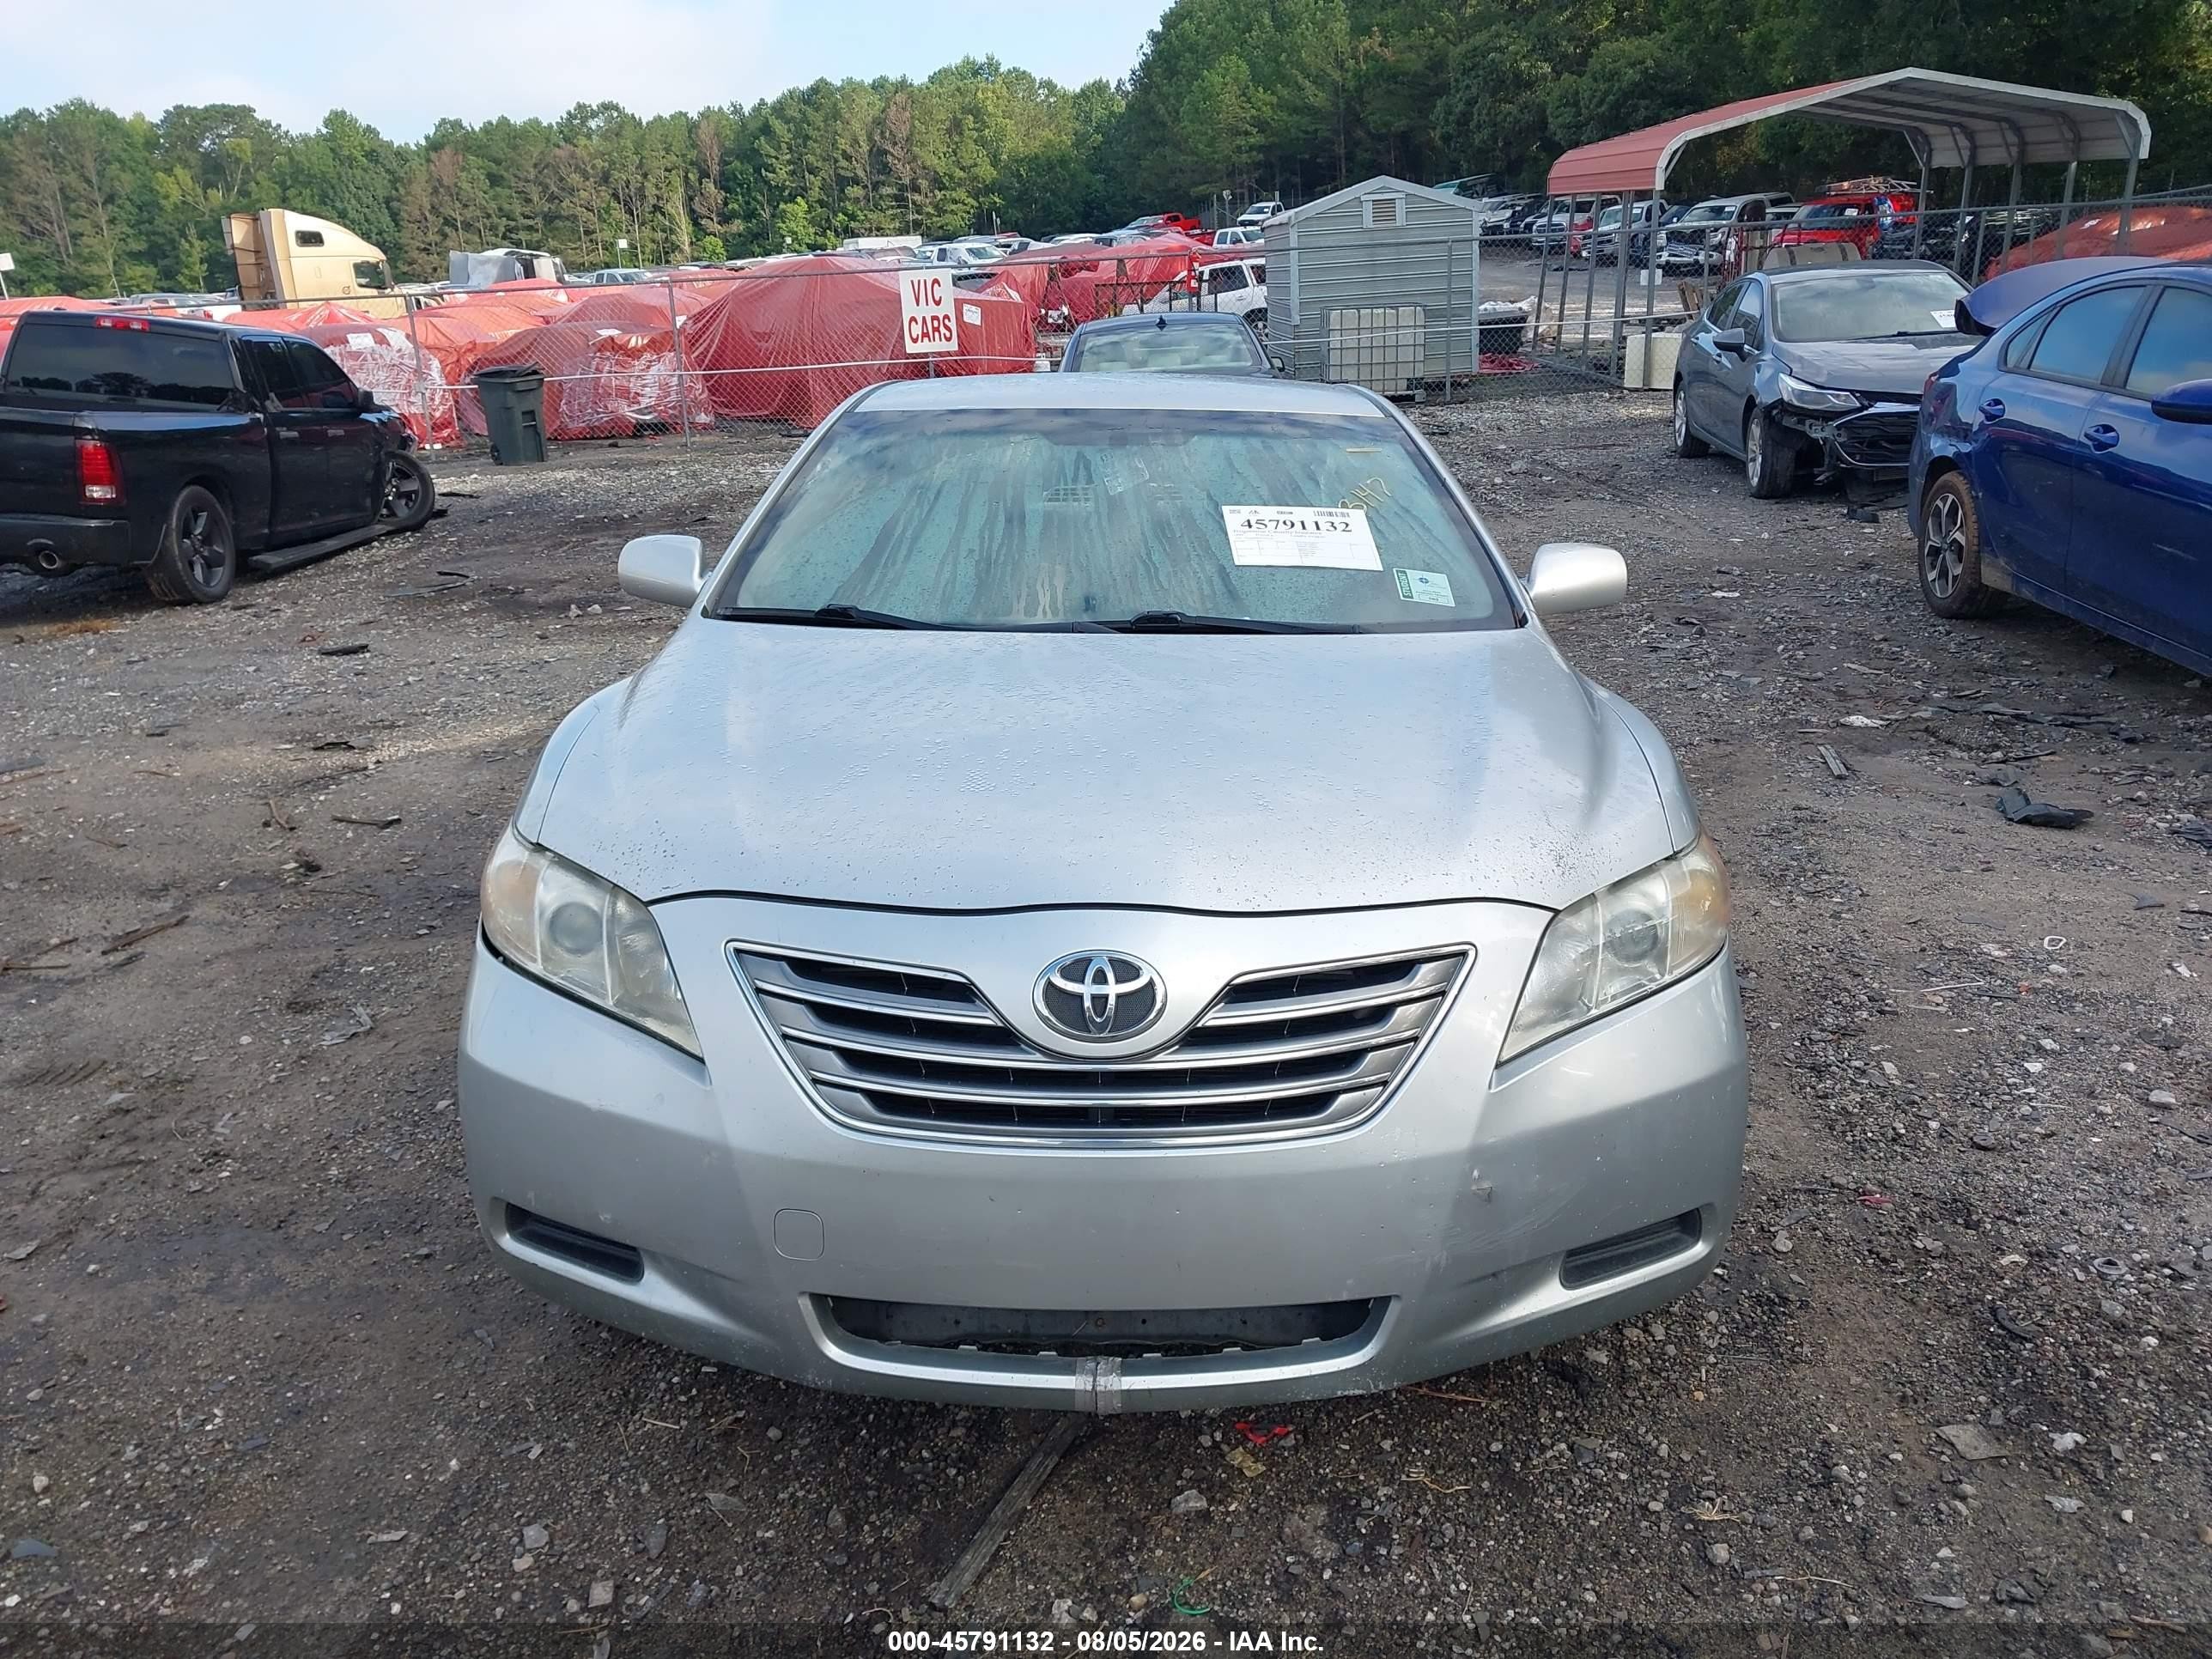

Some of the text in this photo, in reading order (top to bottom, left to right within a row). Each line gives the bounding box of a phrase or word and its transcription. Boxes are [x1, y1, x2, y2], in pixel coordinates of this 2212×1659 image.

[910, 277, 942, 307] VIC
[908, 313, 953, 343] CARS
[1240, 518, 1352, 532] 45791132
[1399, 570, 1412, 598] STUDENT
